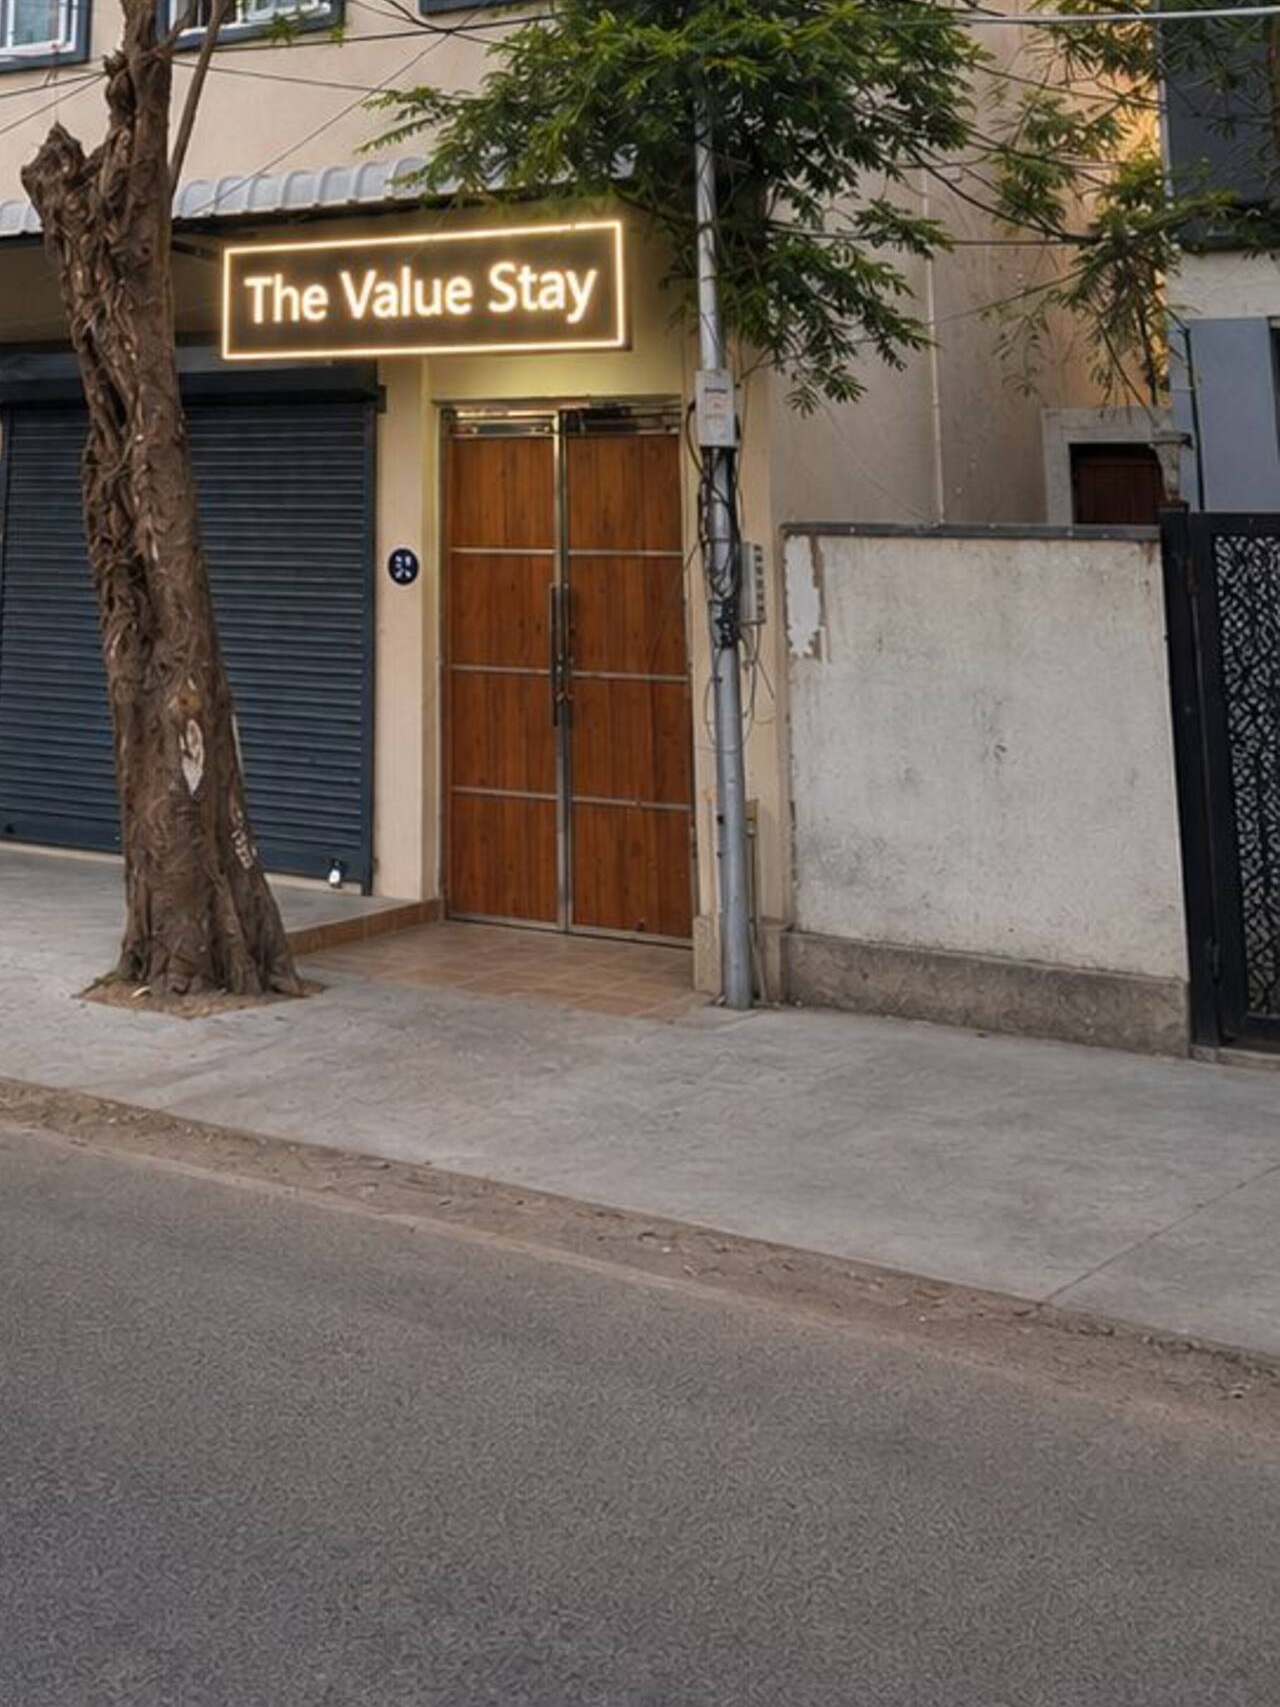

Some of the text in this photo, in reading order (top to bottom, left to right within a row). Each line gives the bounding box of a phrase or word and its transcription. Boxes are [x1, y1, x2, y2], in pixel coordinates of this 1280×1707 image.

[245, 261, 597, 324] The Value Stay
